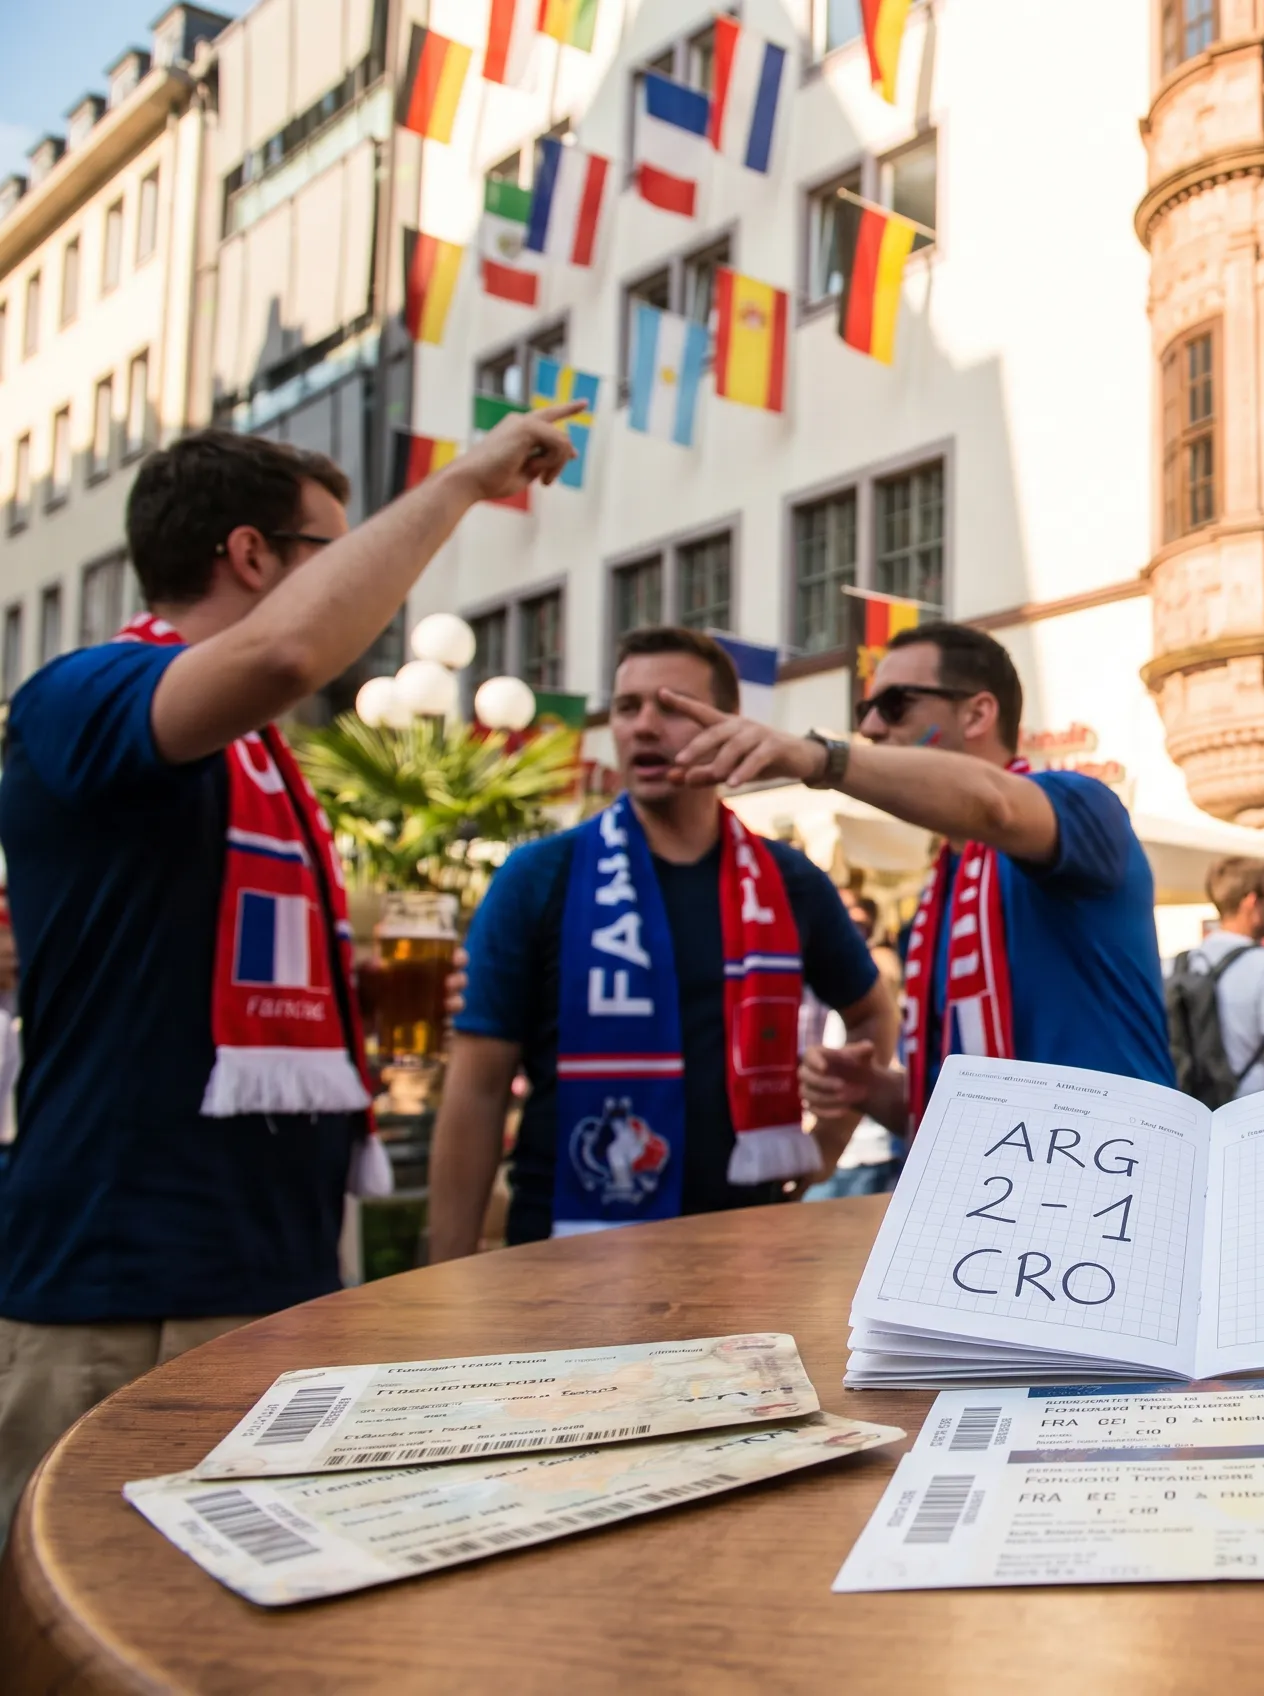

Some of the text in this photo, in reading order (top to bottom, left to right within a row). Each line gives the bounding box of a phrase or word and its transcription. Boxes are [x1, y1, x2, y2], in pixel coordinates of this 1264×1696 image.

[983, 1121, 1140, 1177] ARG
[952, 1248, 1116, 1306] CRO
[1041, 1418, 1079, 1427] FRA
[1018, 1492, 1062, 1503] FRA
